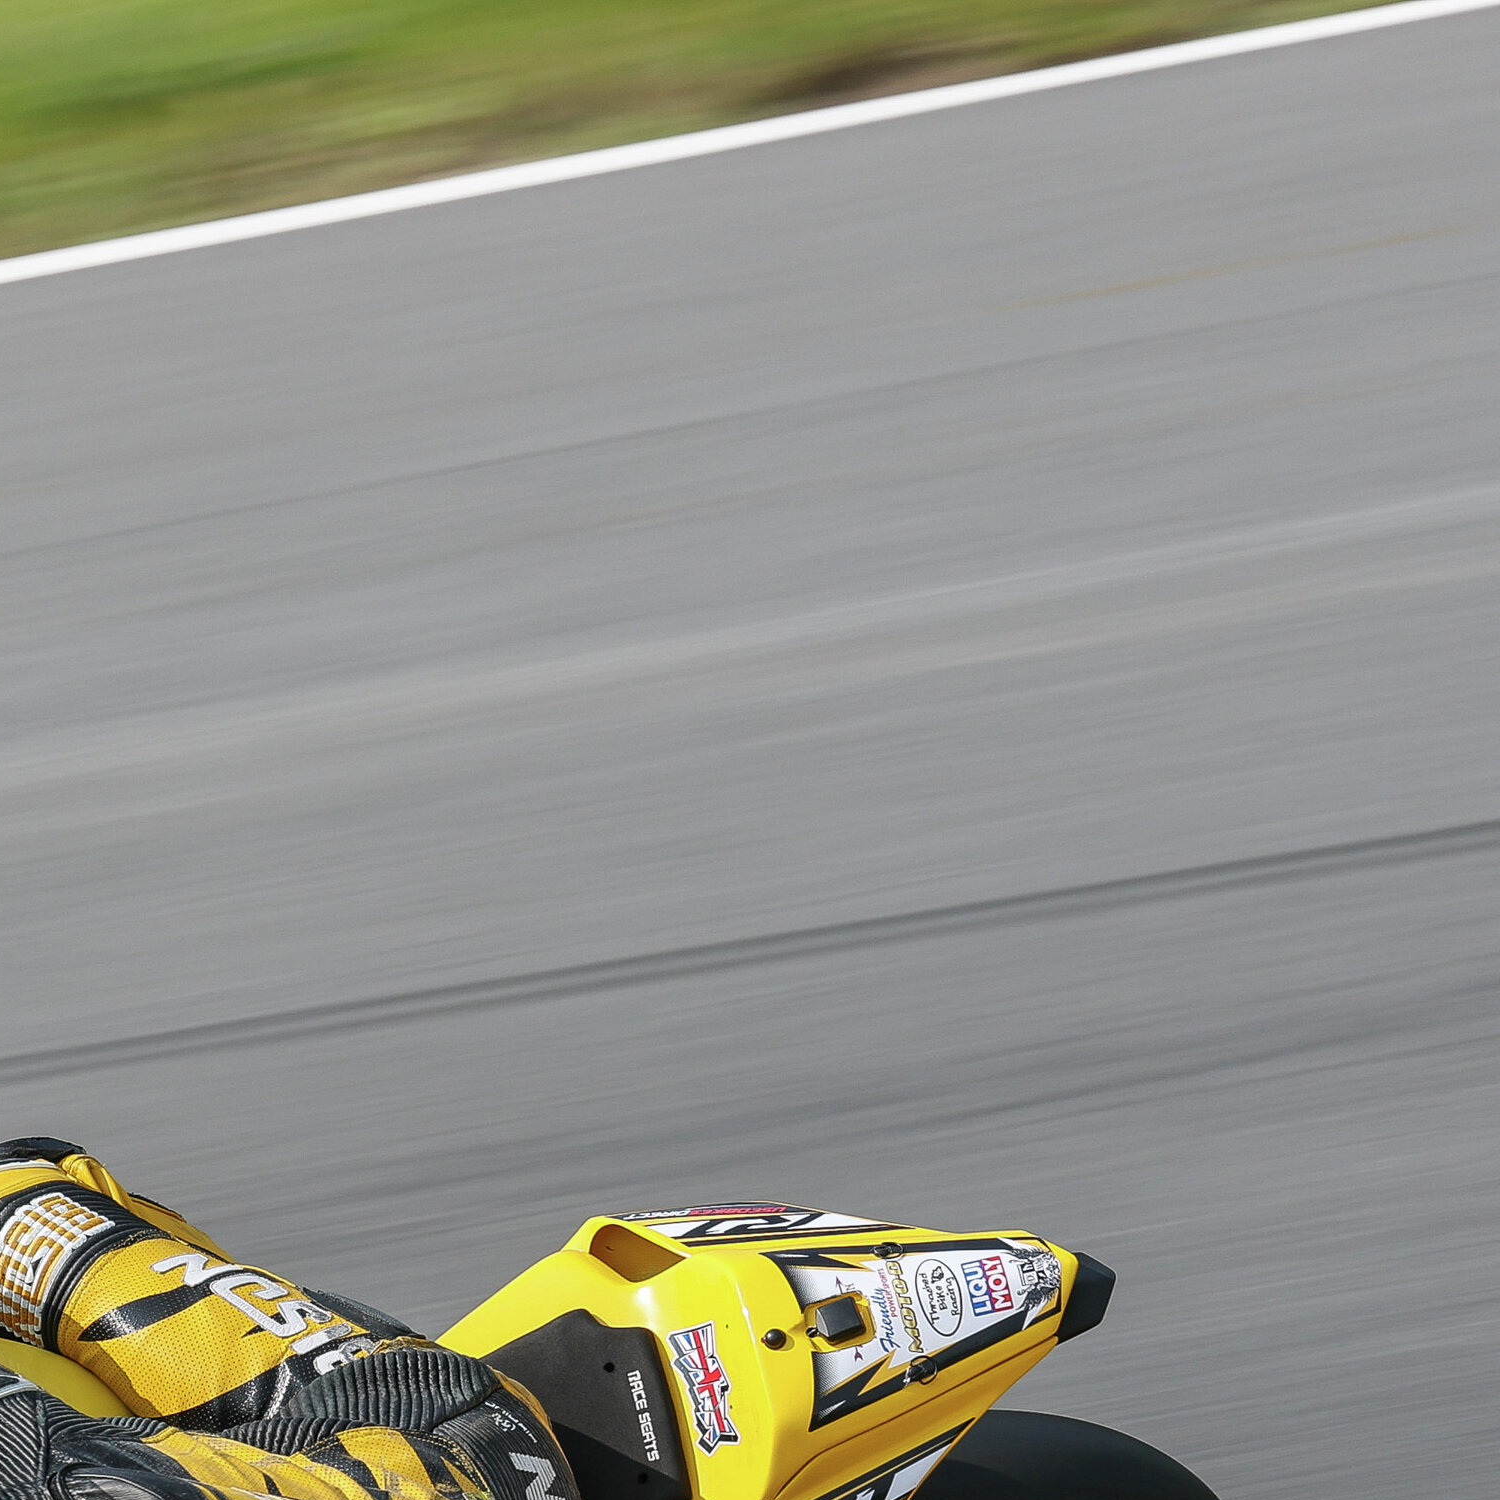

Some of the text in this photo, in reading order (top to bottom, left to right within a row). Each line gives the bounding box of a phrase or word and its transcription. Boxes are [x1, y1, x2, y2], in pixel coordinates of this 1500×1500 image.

[886, 1260, 924, 1353] MOTO-D
[963, 1262, 991, 1314] LIQUI
[982, 1257, 1012, 1311] MOLY
[871, 1288, 901, 1352] Friendly
[627, 1370, 661, 1463] RACE SEATS
